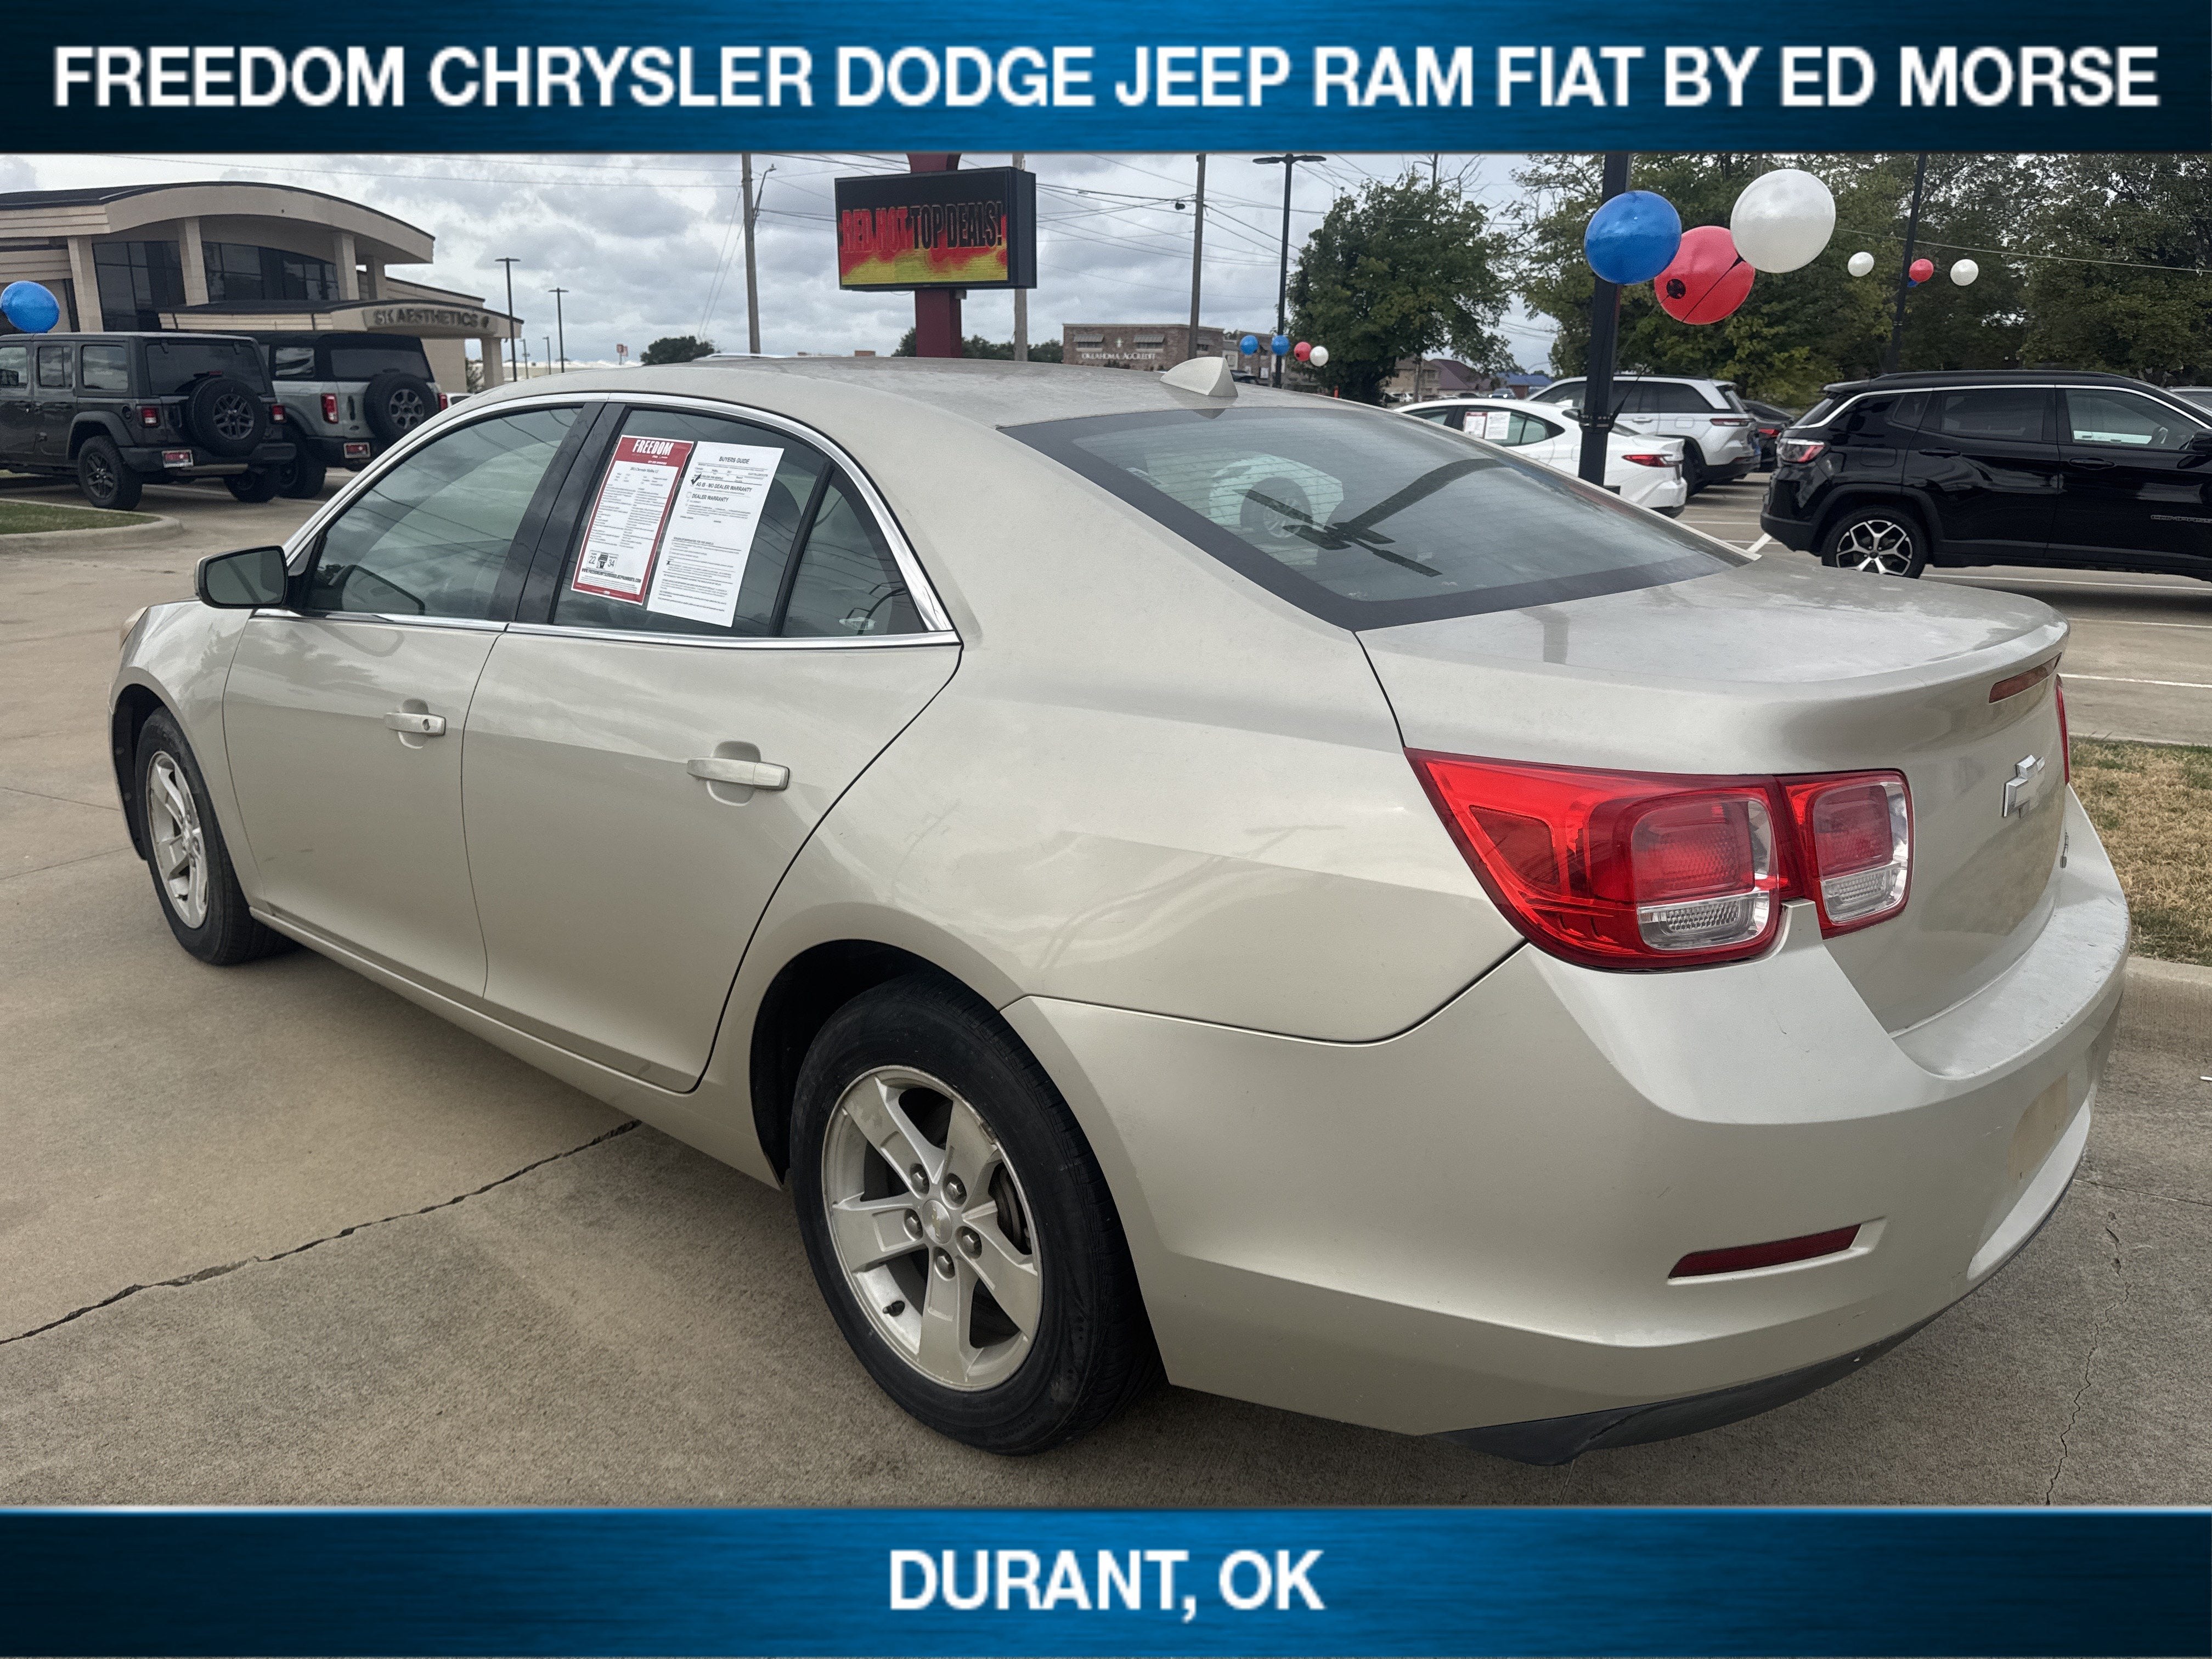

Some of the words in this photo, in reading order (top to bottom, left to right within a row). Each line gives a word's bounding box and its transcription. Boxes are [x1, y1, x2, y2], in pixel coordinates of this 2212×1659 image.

[842, 209, 872, 253] RED
[875, 206, 909, 252] HOT
[910, 204, 945, 251] TOP
[946, 200, 1003, 250] DEALS!
[396, 308, 478, 328] AESTHETICS
[632, 439, 674, 455] FREEDOM
[588, 555, 597, 565] 22
[607, 558, 616, 567] 34
